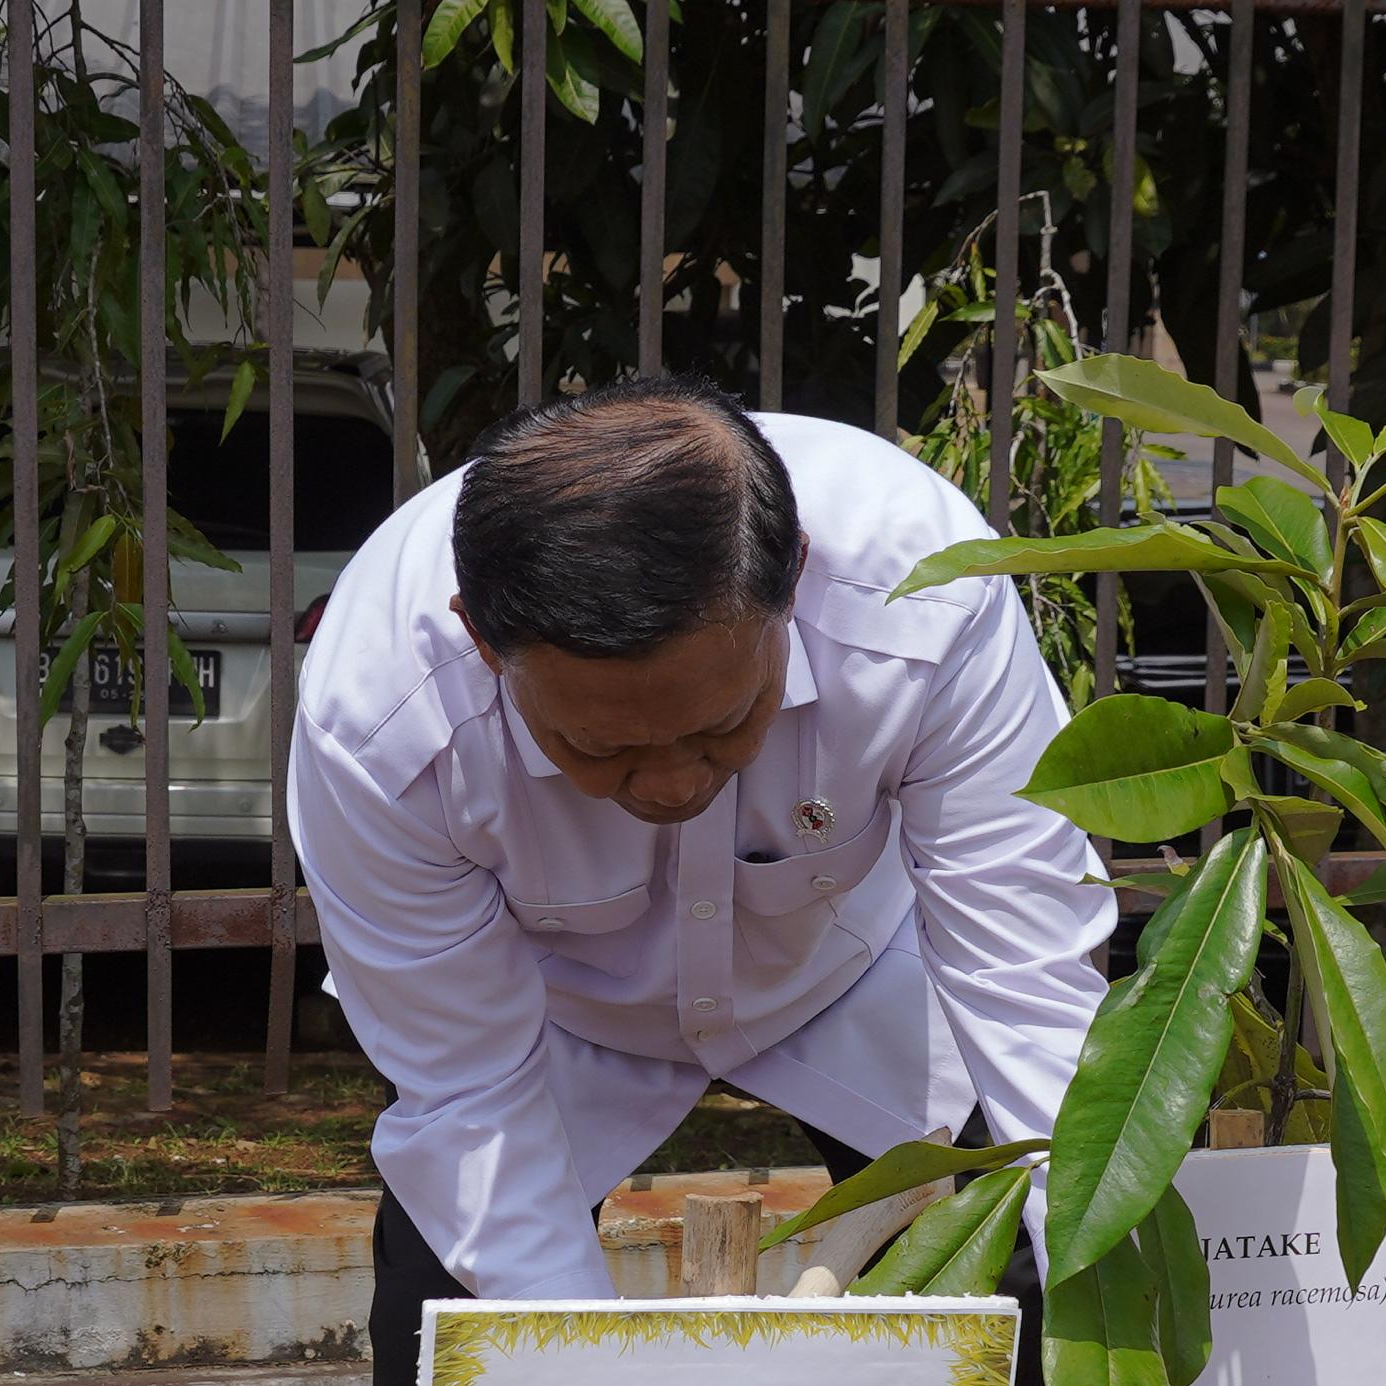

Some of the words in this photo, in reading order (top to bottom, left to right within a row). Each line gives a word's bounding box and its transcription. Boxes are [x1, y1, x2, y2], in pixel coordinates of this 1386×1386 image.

[93, 654, 144, 686] 619
[1201, 1232, 1321, 1263] JATAKE
[1210, 1290, 1262, 1310] urea
